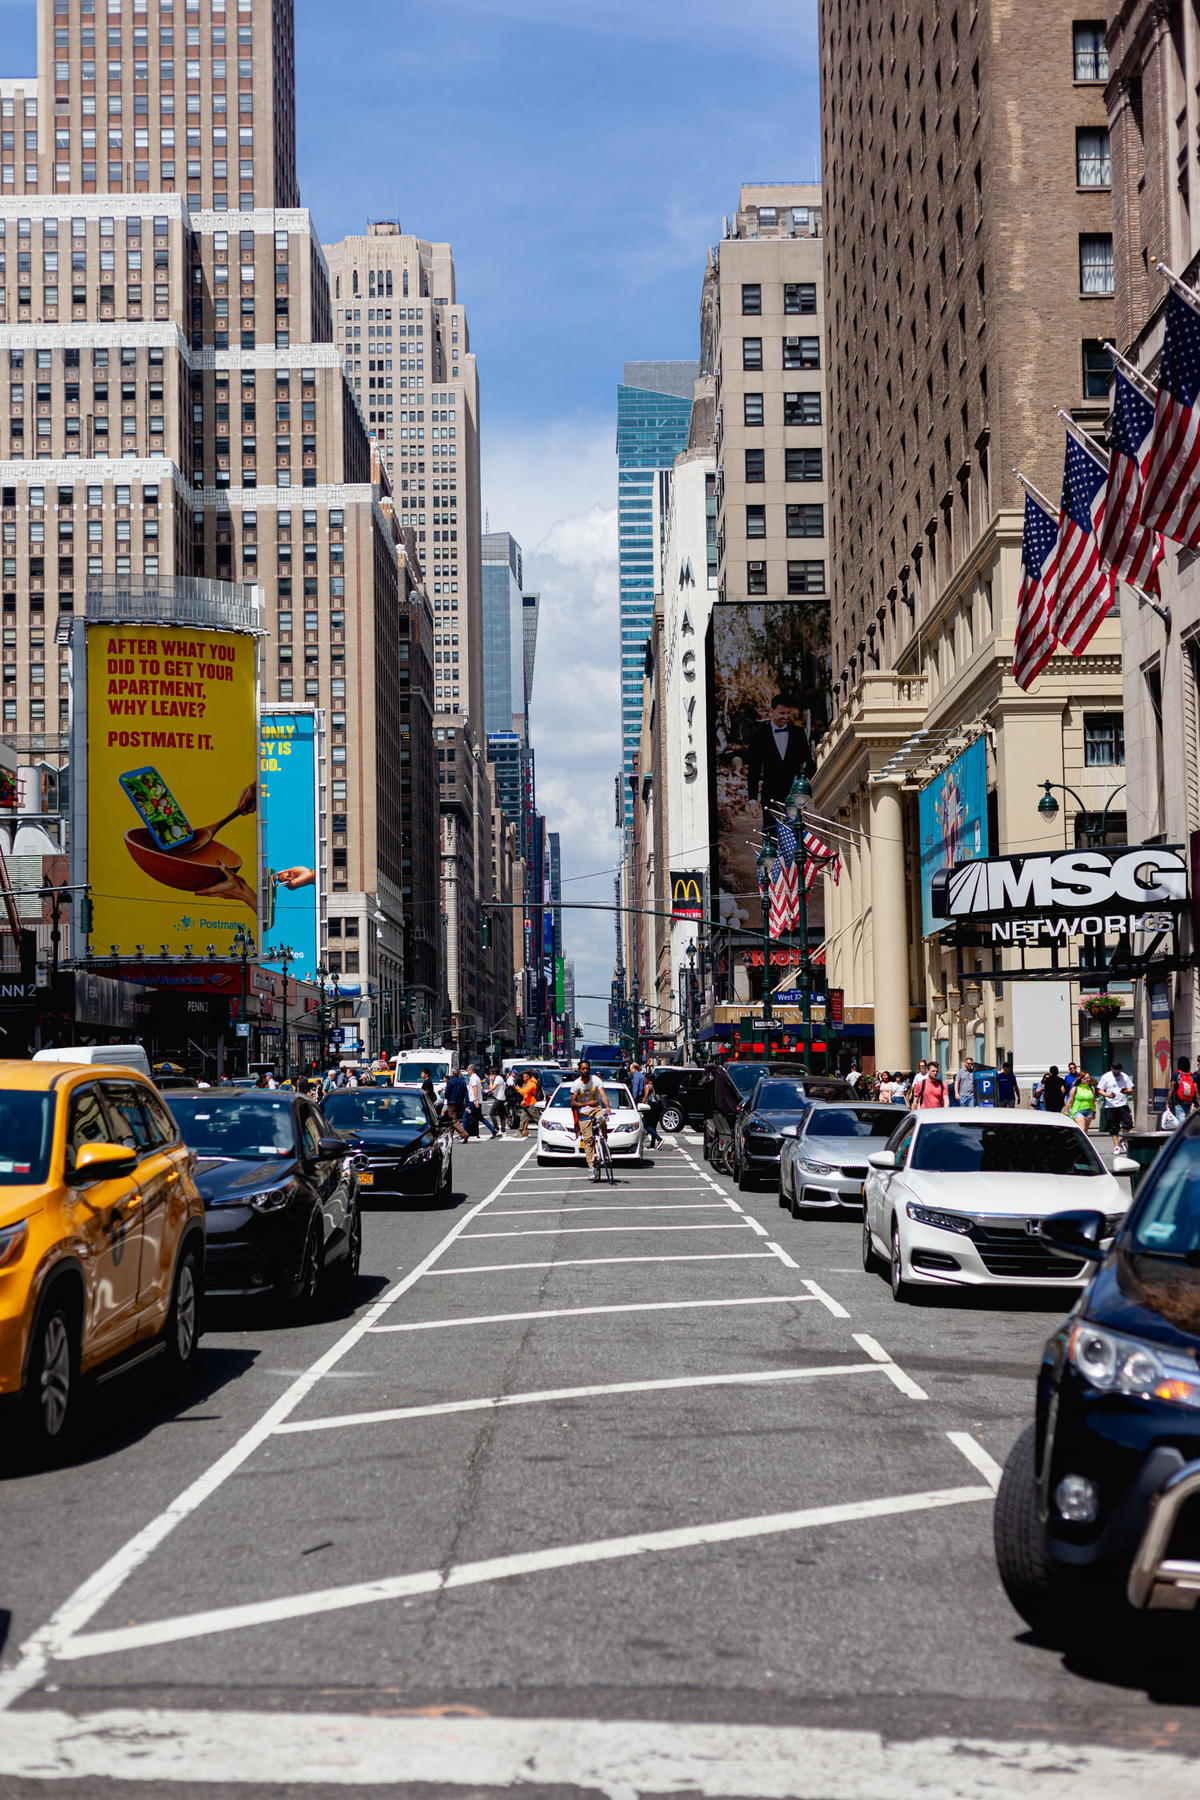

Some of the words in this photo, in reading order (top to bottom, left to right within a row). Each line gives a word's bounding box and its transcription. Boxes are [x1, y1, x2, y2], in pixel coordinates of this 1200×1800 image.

[107, 639, 157, 655] AFTER
[161, 640, 206, 658] WHAT
[209, 643, 235, 662] YOU
[107, 659, 135, 675] DID
[139, 659, 160, 675] TO
[164, 660, 193, 677] GET
[197, 662, 234, 682] YOUR
[679, 556, 698, 784] MACY'S
[107, 679, 207, 699] APARTMENT,
[108, 699, 147, 716] WHY
[151, 700, 206, 718] LEAVE?
[107, 731, 195, 749] POSTMATE
[197, 734, 214, 750] IT.
[261, 725, 295, 739] ONLY
[278, 742, 292, 755] IS
[987, 850, 1187, 910] MSG
[199, 918, 246, 930] Postmates
[991, 913, 1175, 941] NETWORKS
[0, 984, 24, 997] NN
[28, 984, 36, 996] 2
[777, 993, 793, 1001] West
[204, 1001, 209, 1012] 2
[983, 1080, 991, 1093] P
